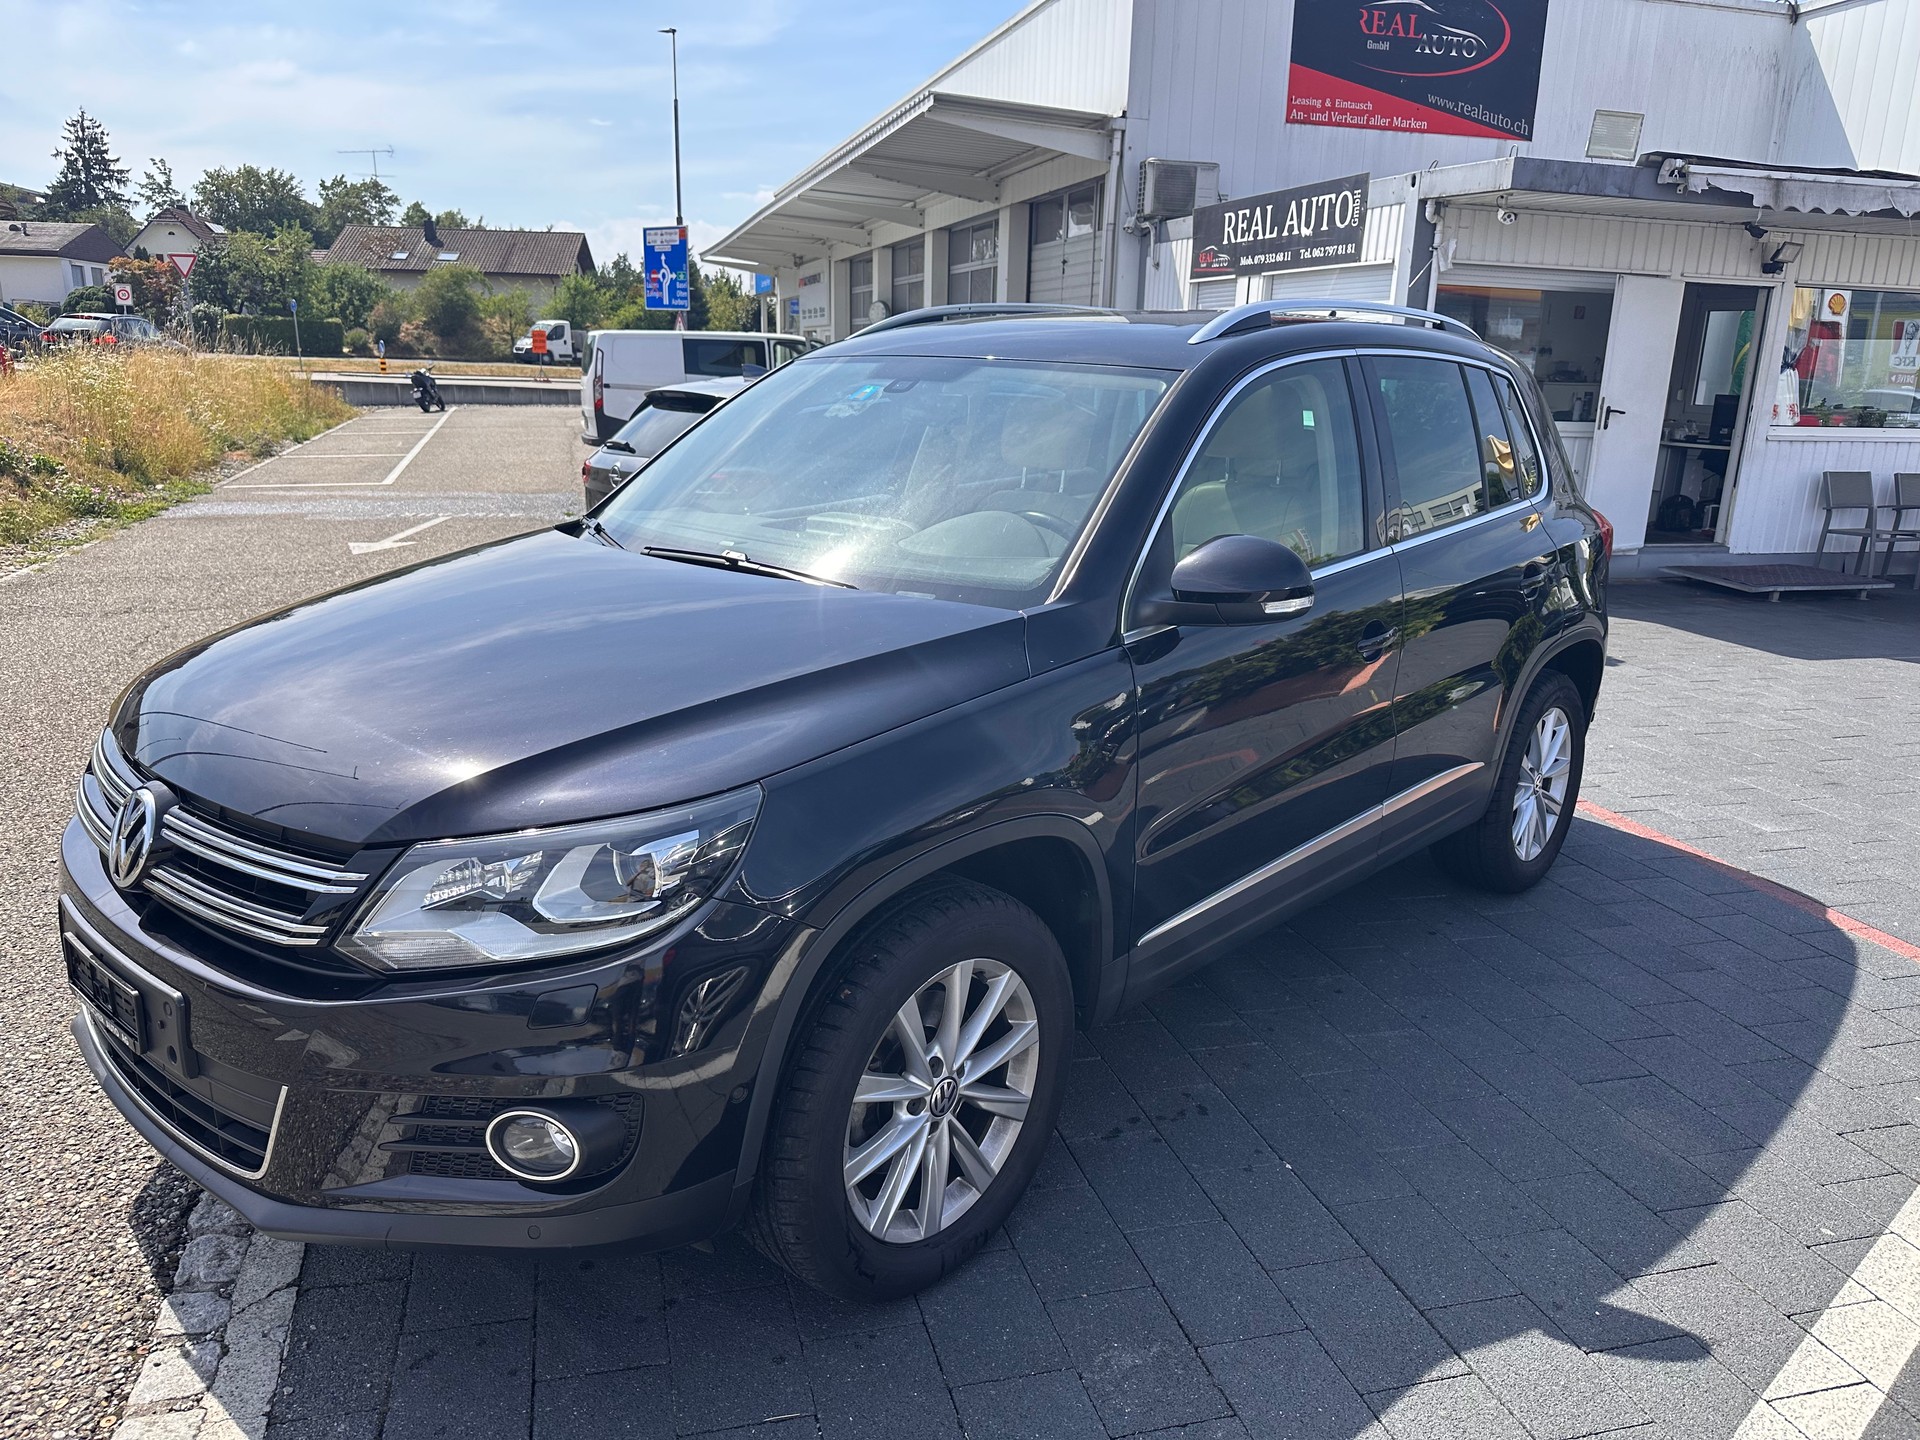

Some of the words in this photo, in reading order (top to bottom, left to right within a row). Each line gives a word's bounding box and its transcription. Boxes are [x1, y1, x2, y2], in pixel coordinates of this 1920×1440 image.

[1360, 8, 1423, 39] REAL
[1367, 40, 1390, 51] GmbH
[1415, 33, 1478, 58] AUTO
[1292, 95, 1322, 108] Leasing
[1325, 98, 1332, 107] &
[1335, 98, 1373, 110] Eintausch
[1428, 93, 1529, 135] www.realauto.ch
[1290, 109, 1308, 120] An-
[1310, 111, 1329, 122] und
[1331, 111, 1369, 125] Verkauf
[1369, 114, 1391, 127] aller
[1392, 117, 1428, 130] Marken
[1222, 204, 1278, 245] REAL
[1281, 190, 1353, 237] AUTO
[1351, 189, 1361, 227] GmbH
[1300, 247, 1311, 259] Tel.
[1312, 246, 1324, 258] 062
[1325, 244, 1338, 256] 797
[1337, 244, 1346, 255] 81
[1347, 243, 1356, 254] 81
